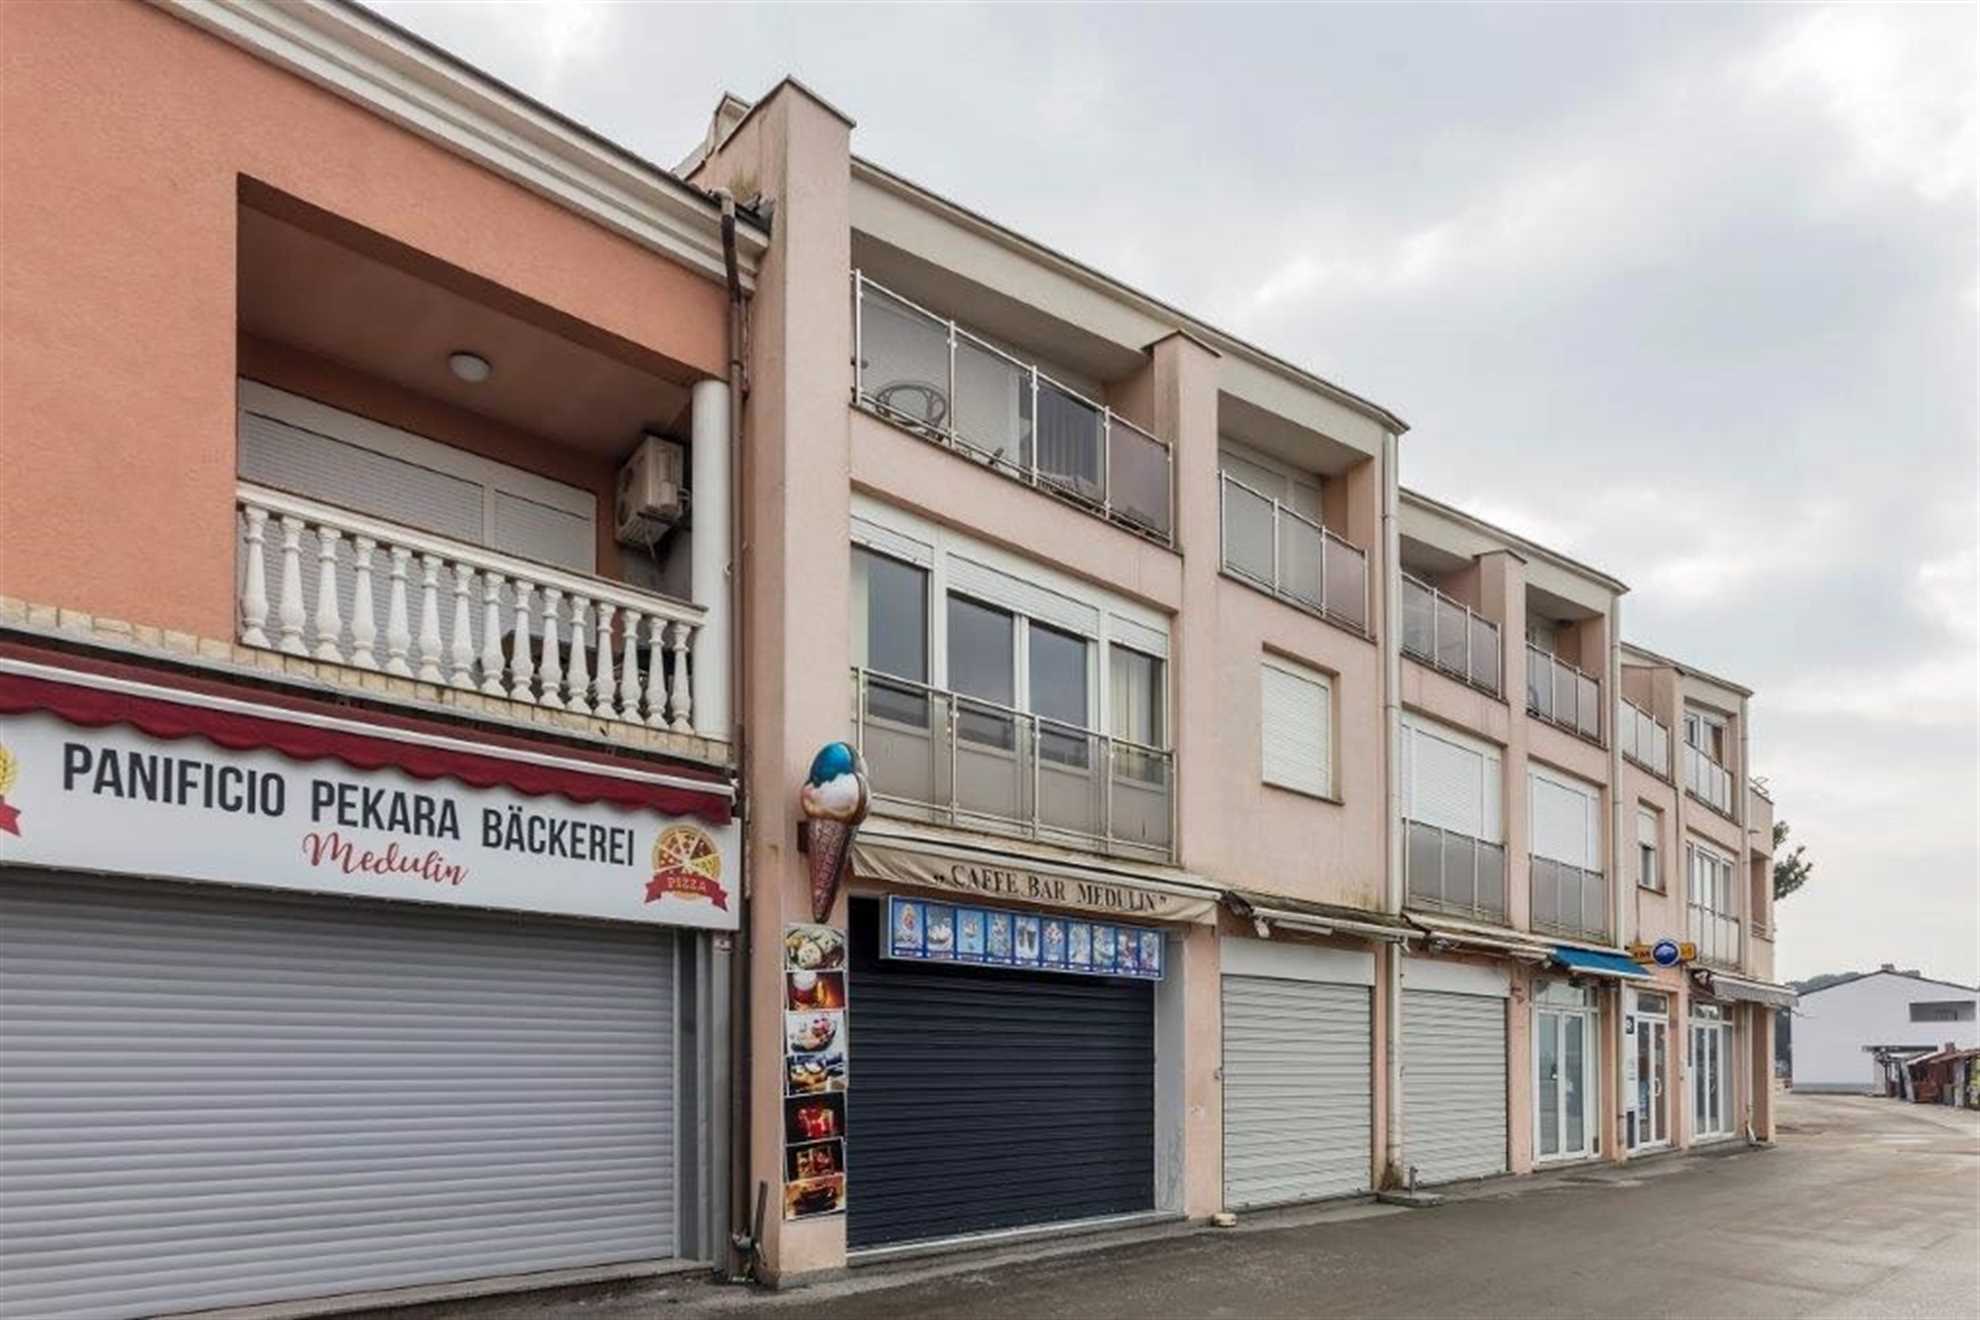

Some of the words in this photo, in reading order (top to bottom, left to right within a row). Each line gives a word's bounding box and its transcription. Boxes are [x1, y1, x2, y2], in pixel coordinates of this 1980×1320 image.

[63, 742, 285, 817] PANIFICIO
[311, 779, 461, 840] PEKARA
[482, 805, 635, 867] BÄCKEREI
[302, 831, 468, 886] Medulin
[667, 876, 706, 892] PIZZA
[1026, 875, 1066, 901] BAR
